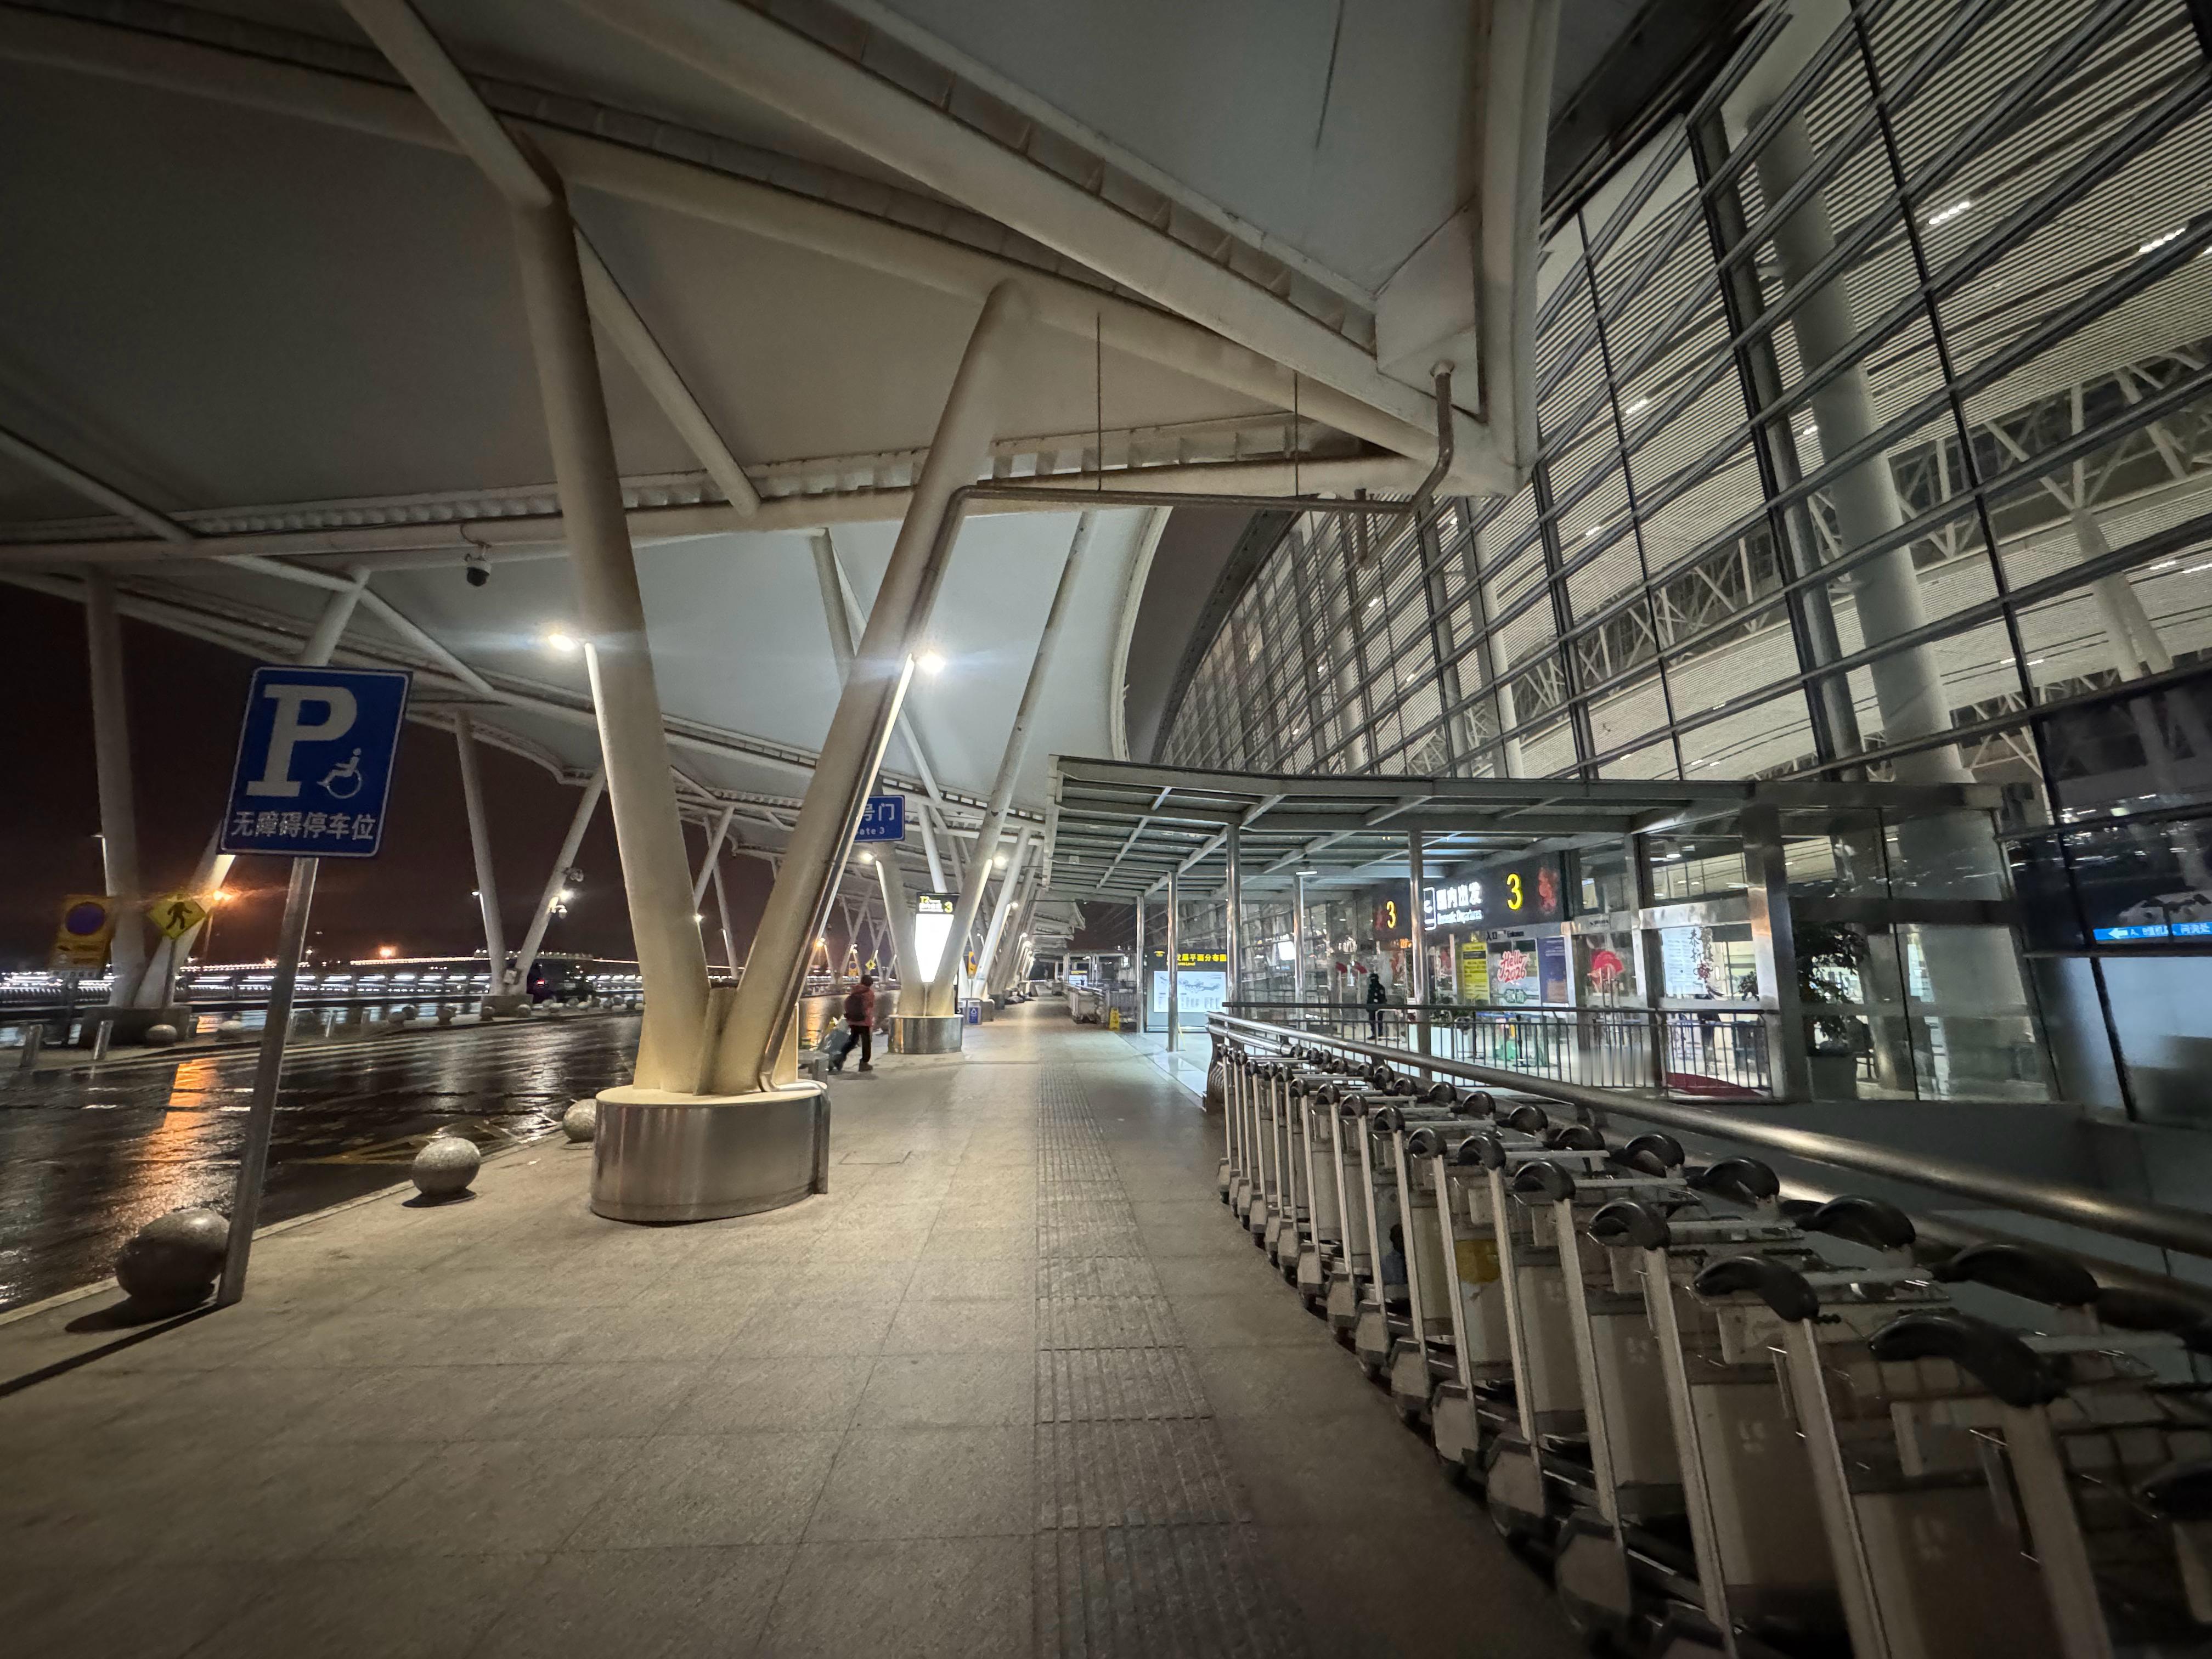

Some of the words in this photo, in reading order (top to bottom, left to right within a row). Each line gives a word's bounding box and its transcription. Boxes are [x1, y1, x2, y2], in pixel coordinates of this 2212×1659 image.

[246, 684, 358, 797] P
[231, 811, 376, 840] 无障碍停车位
[1507, 874, 1523, 910] 3
[944, 901, 953, 913] 3
[1386, 901, 1396, 928] 3
[1486, 930, 1497, 941] 入口
[1500, 951, 1527, 971] Hello
[1504, 961, 1526, 983] 2026
